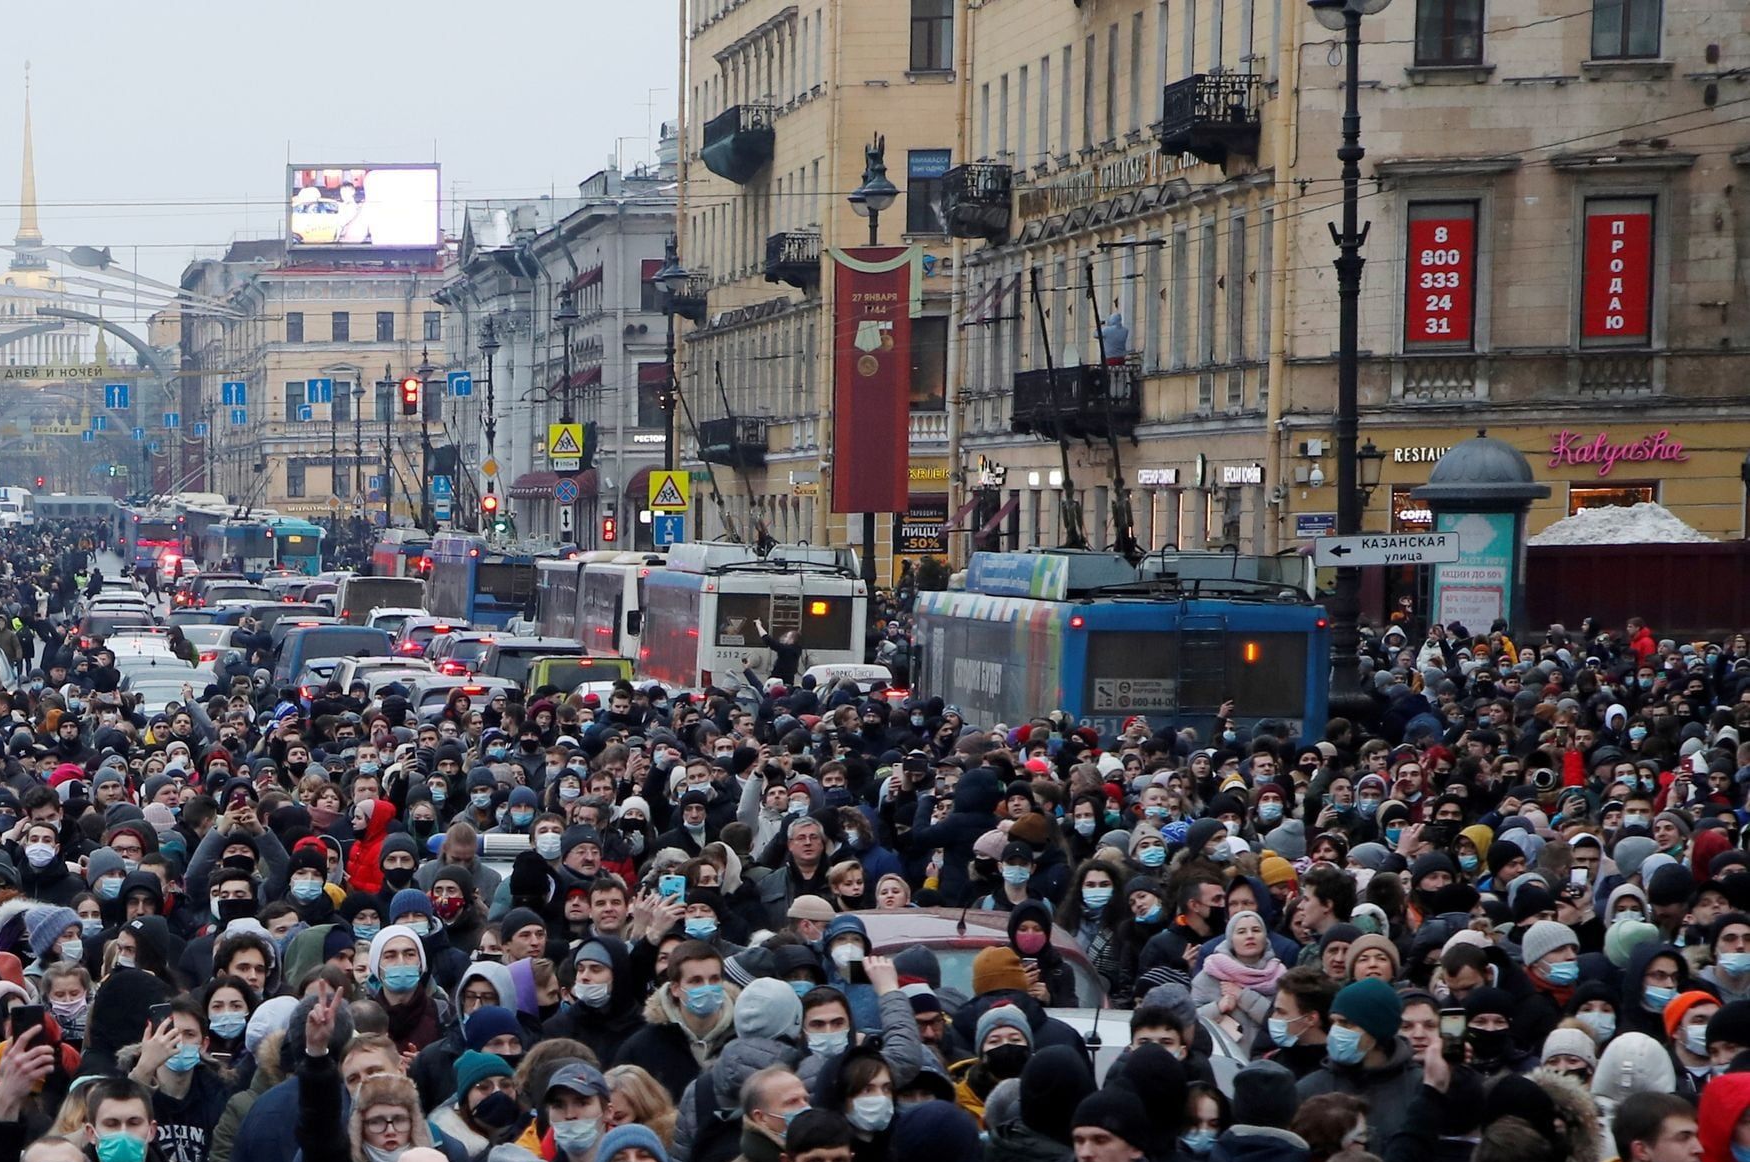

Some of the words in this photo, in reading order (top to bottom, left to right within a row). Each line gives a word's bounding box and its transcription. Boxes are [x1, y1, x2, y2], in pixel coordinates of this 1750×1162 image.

[1434, 226, 1448, 243] 8
[1420, 249, 1460, 266] 800
[1419, 271, 1460, 289] 333
[1605, 220, 1625, 329] ПРОДАЮ
[852, 293, 863, 302] 27
[863, 293, 898, 302] ЯНВАРЯ
[1425, 294, 1452, 311] 24
[1425, 317, 1451, 334] 31
[5, 367, 39, 379] ДНЕЙ
[46, 368, 55, 378] И
[59, 365, 103, 378] НОЧЕЙ
[1394, 446, 1451, 463] RESTAU
[1548, 429, 1691, 477] Katyusha
[902, 527, 939, 537] ПИЦЦ
[904, 538, 940, 548] -50%
[1362, 536, 1446, 549] КАЗАНСКАЯ
[1384, 552, 1423, 564] улица
[716, 651, 740, 659] 2512
